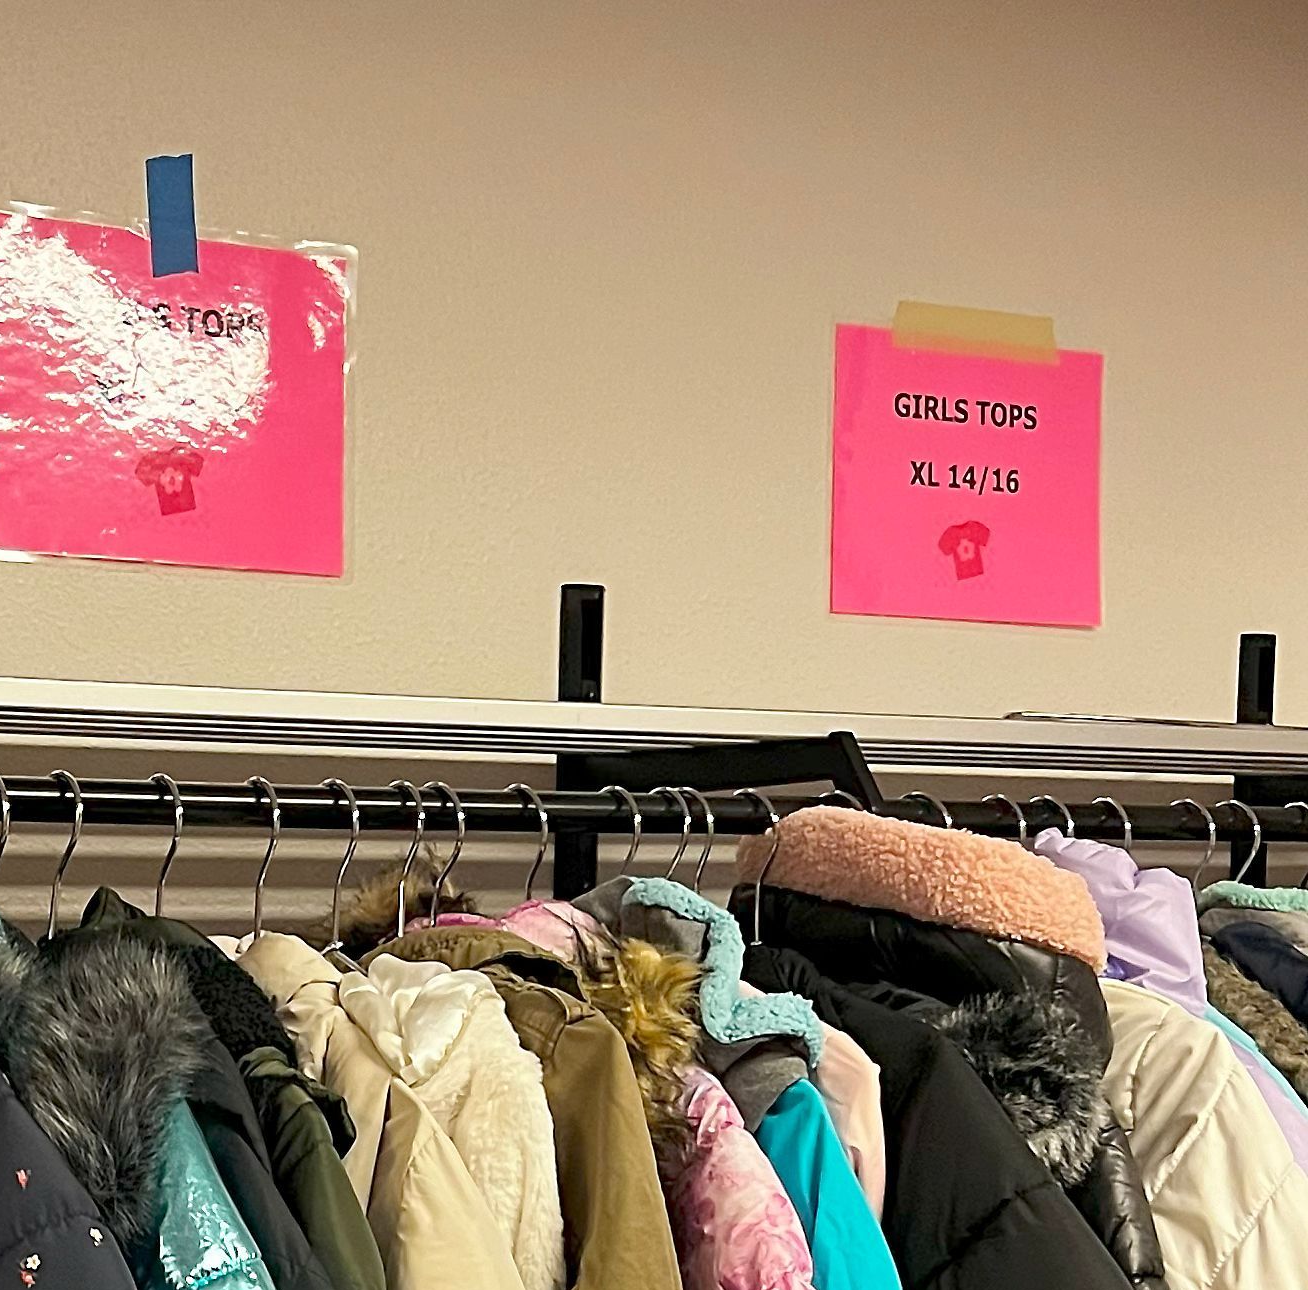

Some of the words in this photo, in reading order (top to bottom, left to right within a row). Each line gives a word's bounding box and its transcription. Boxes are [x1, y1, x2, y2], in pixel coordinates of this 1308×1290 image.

[894, 392, 969, 424] GIRLS
[975, 400, 1037, 430] TOPS
[910, 460, 940, 487] XL
[948, 464, 1019, 496] 14/16
